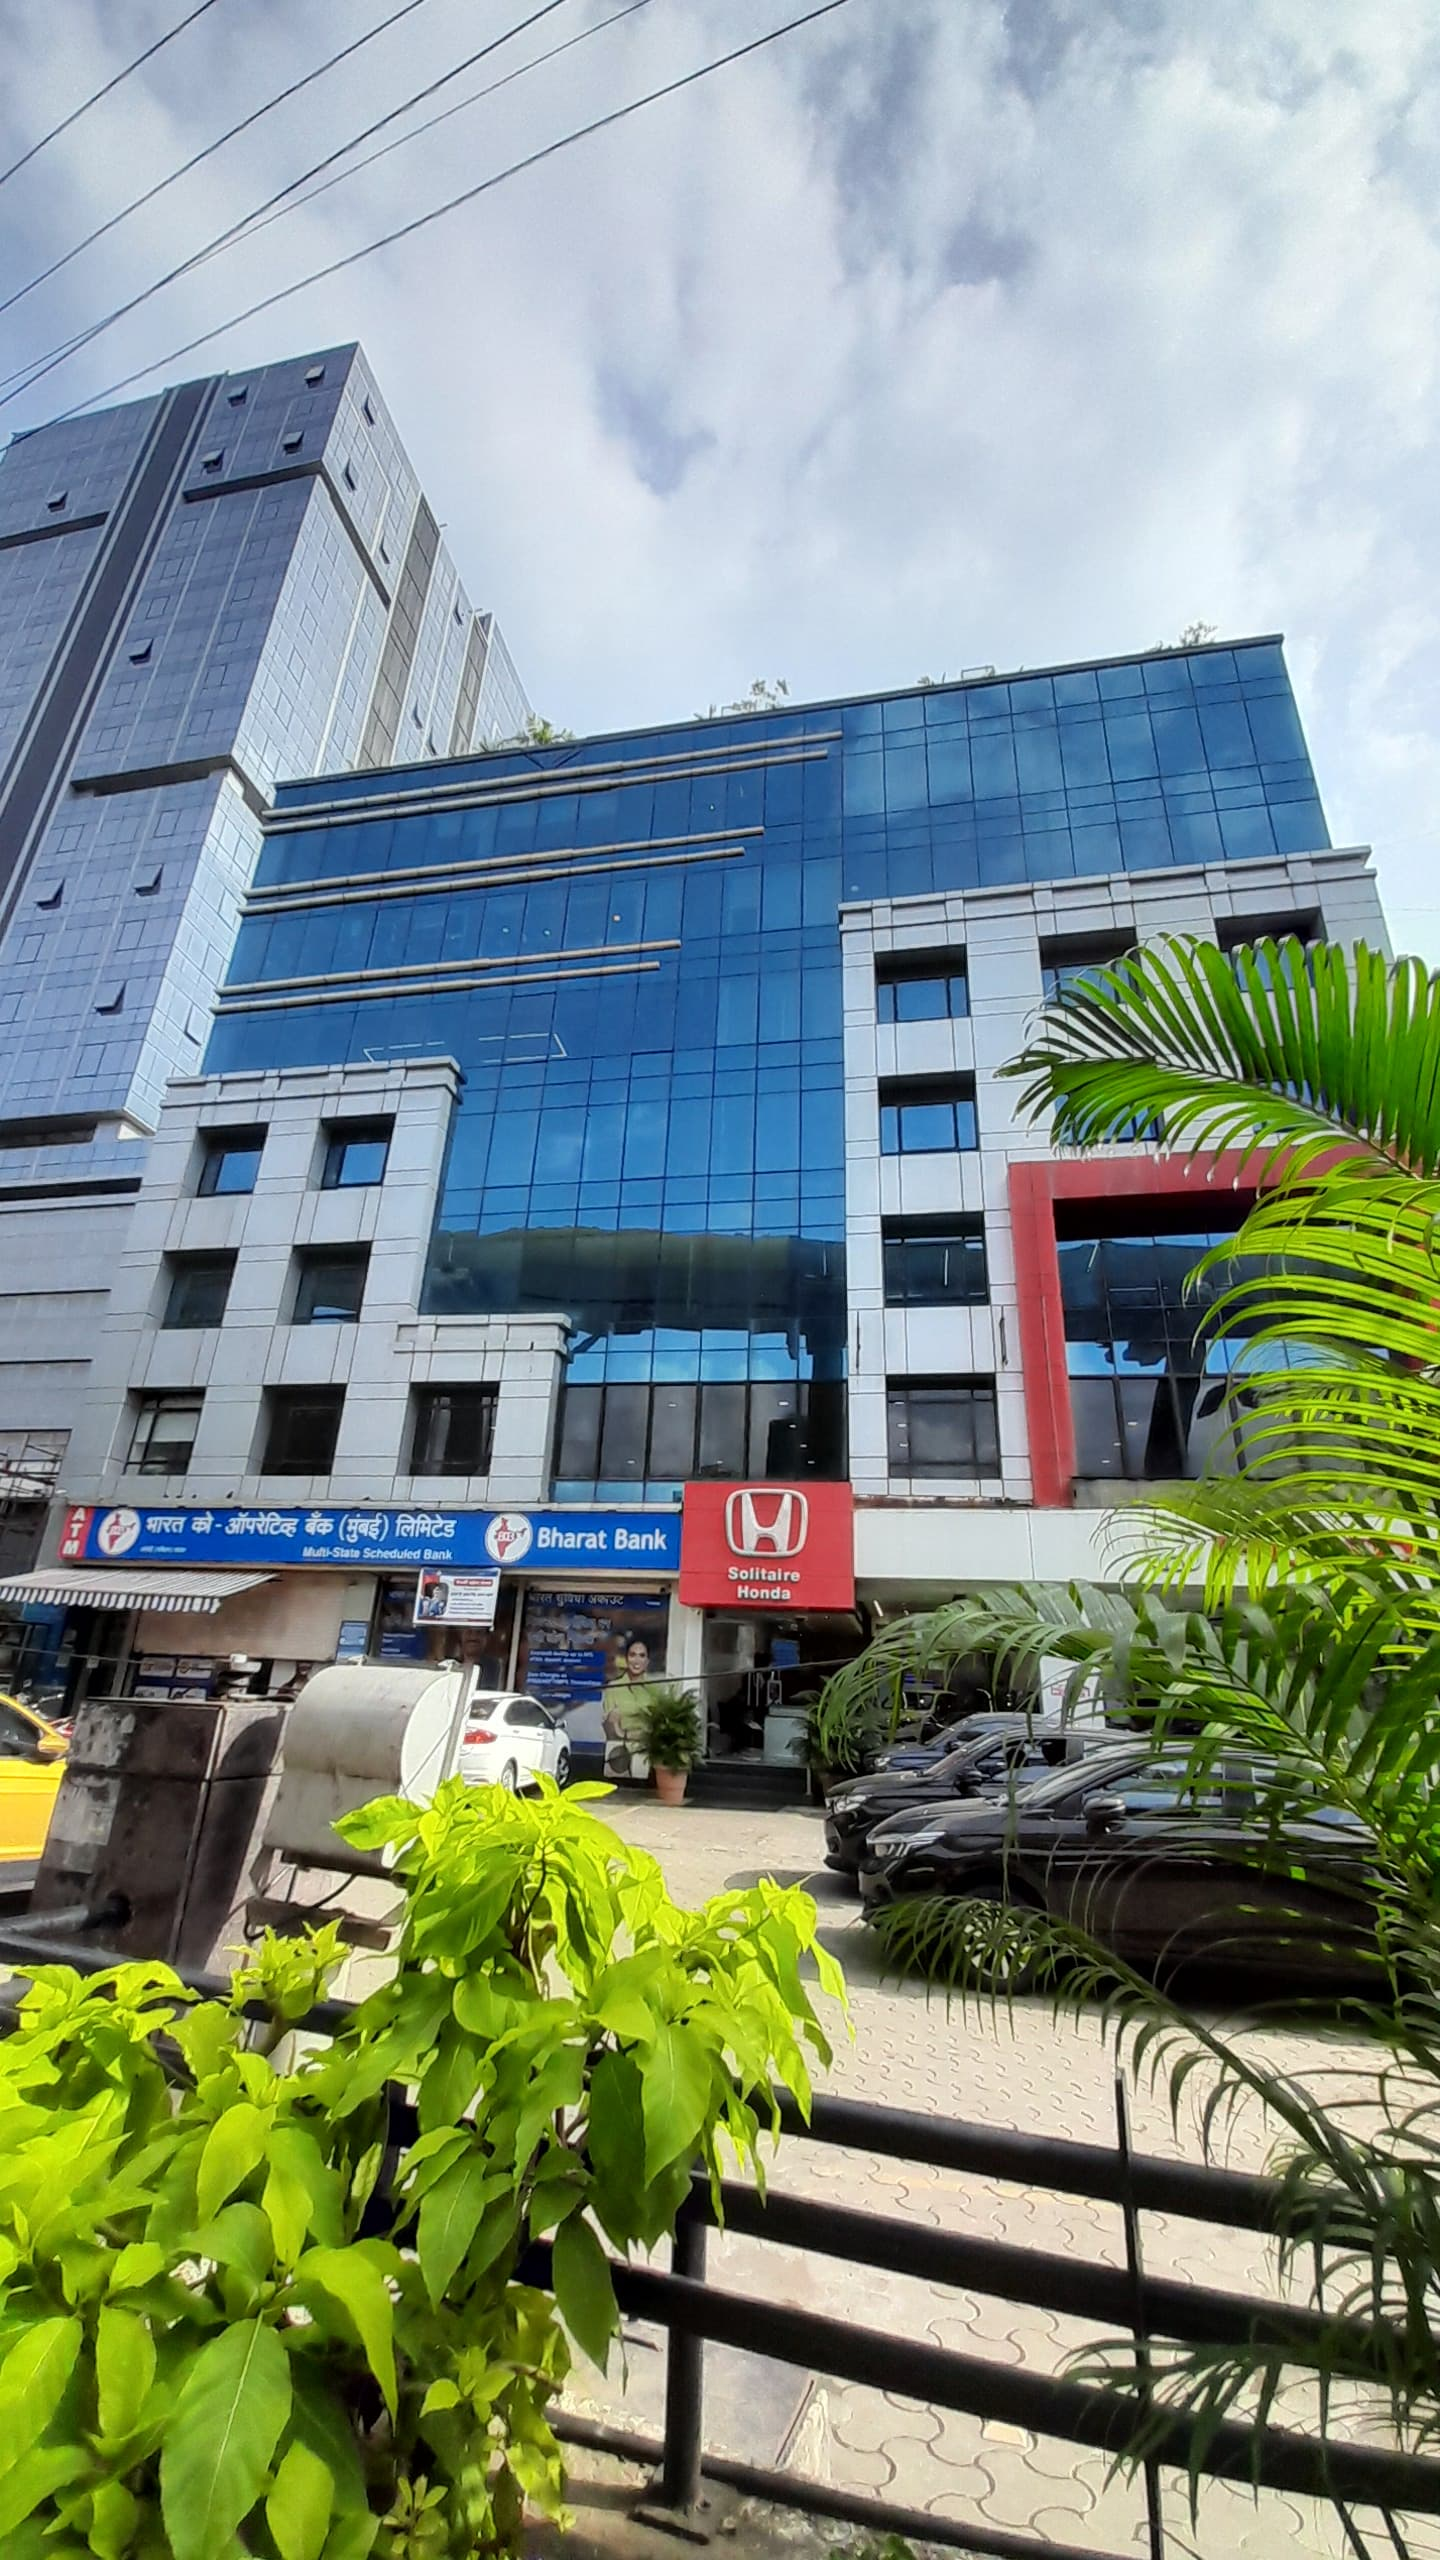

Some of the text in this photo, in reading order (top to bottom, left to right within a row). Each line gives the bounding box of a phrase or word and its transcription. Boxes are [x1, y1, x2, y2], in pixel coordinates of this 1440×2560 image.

[62, 1506, 87, 1556] ATM
[145, 1515, 187, 1534] भारत
[338, 1512, 389, 1543] (मुंबई)
[395, 1513, 457, 1538] लिमिटेड
[537, 1526, 667, 1550] Bharat Bank
[302, 1546, 453, 1561] Multi-State Scheduled Bank
[728, 1566, 801, 1583] Solitaire
[737, 1585, 792, 1601] Honda
